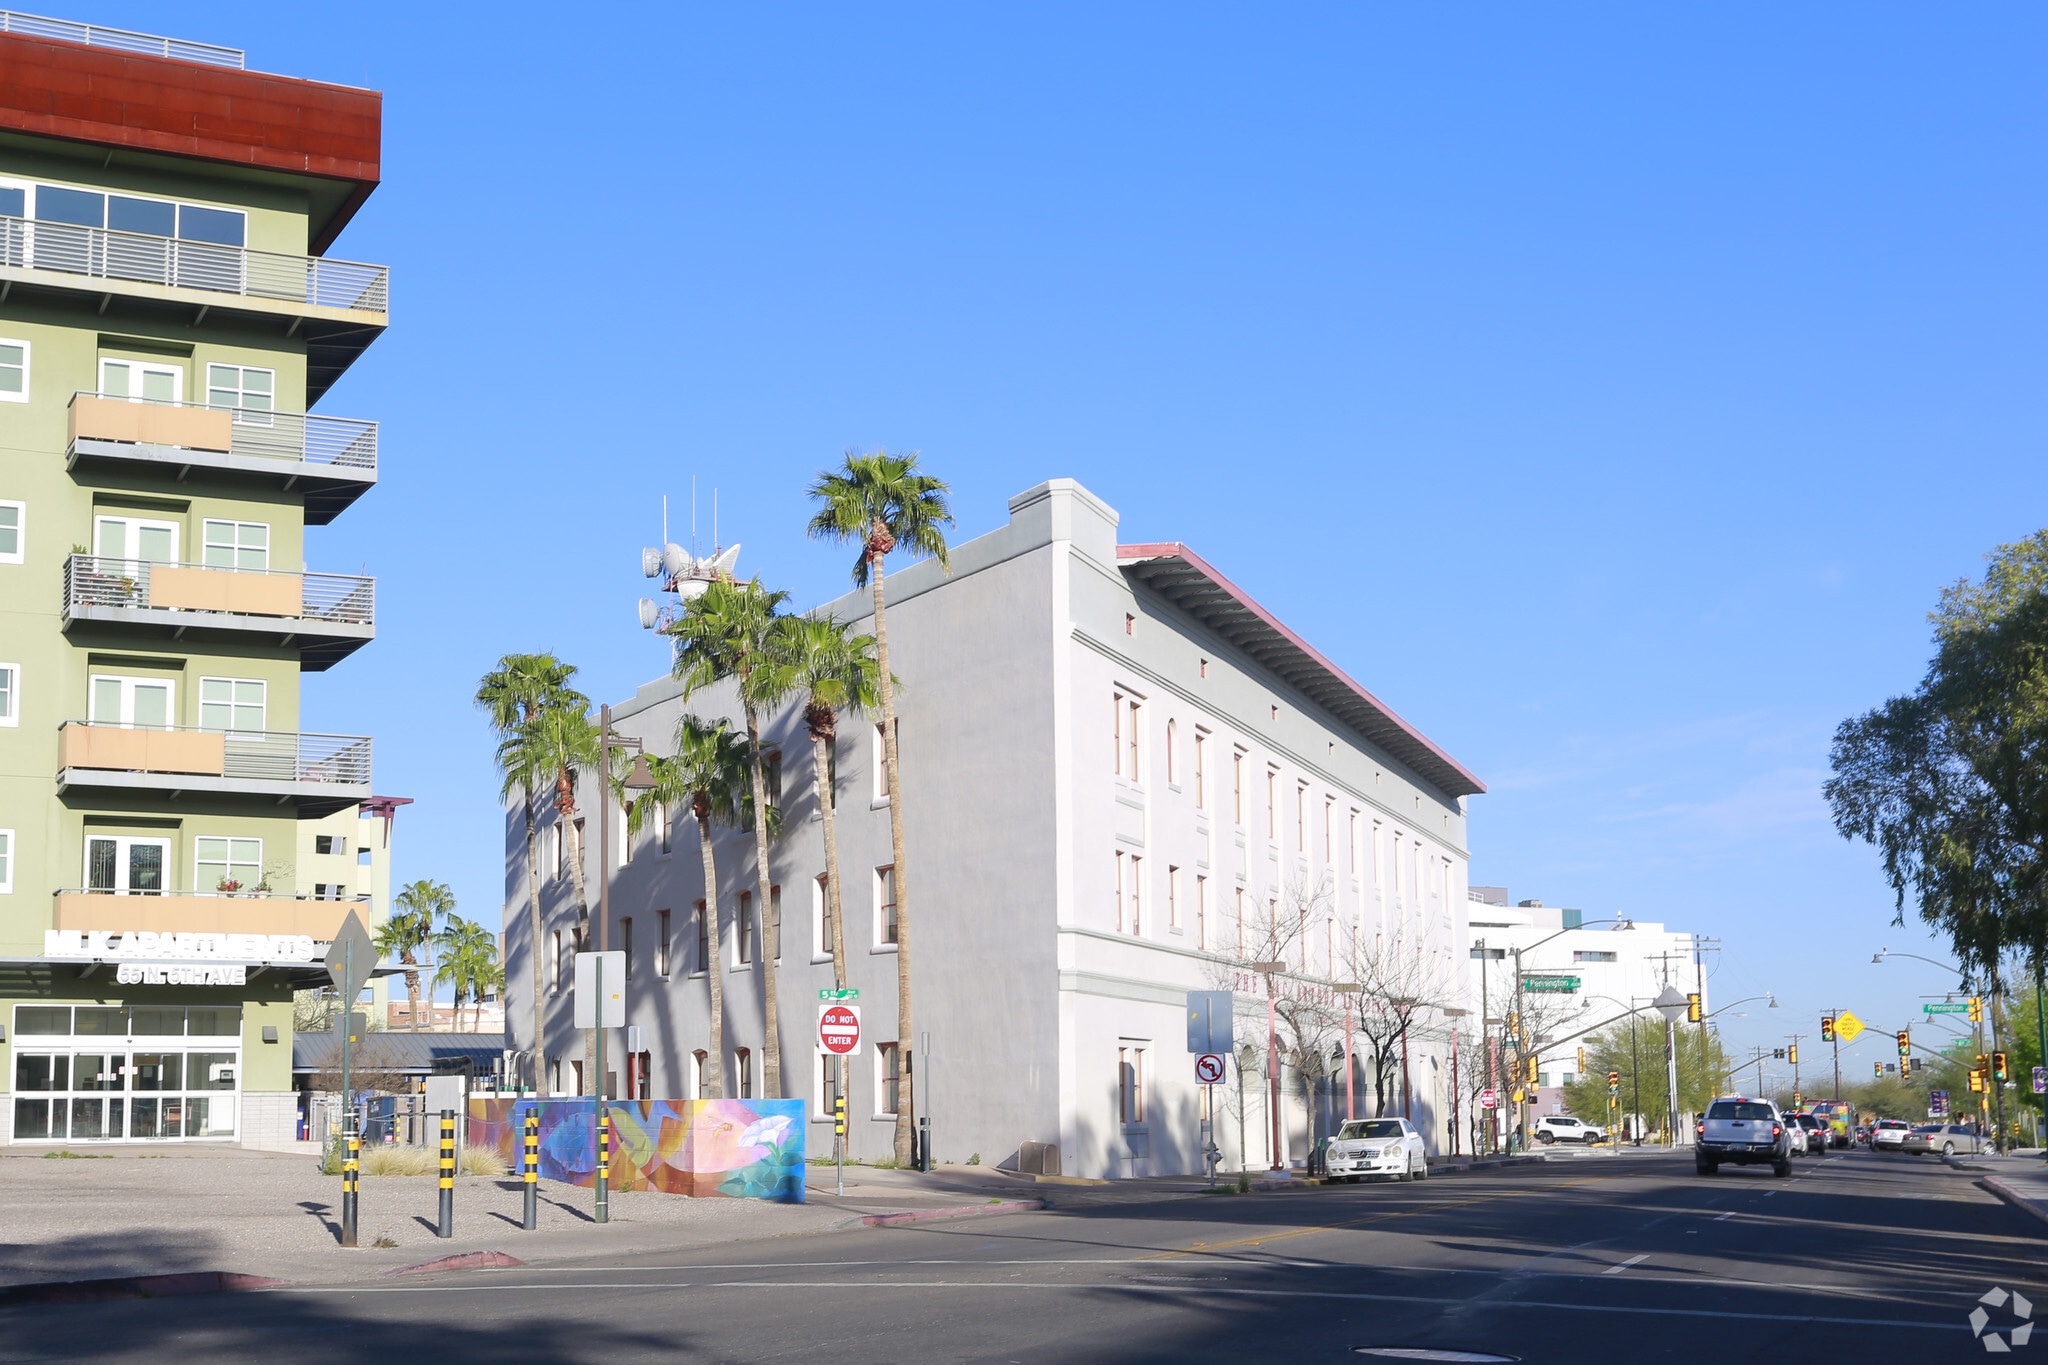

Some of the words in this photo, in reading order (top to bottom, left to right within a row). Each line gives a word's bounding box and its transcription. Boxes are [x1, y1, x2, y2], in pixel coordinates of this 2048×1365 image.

[44, 929, 117, 958] MLK
[117, 930, 315, 962] APARTMENTS
[119, 964, 142, 984] 55
[144, 964, 167, 984] N.
[168, 965, 206, 985] 5TH
[207, 965, 246, 985] AVE
[1235, 972, 1257, 993] THE
[1530, 978, 1569, 988] Pennington
[1927, 1004, 1963, 1012] Pennington
[825, 1014, 836, 1023] DO
[839, 1015, 855, 1024] NOT
[828, 1036, 852, 1045] ENTER
